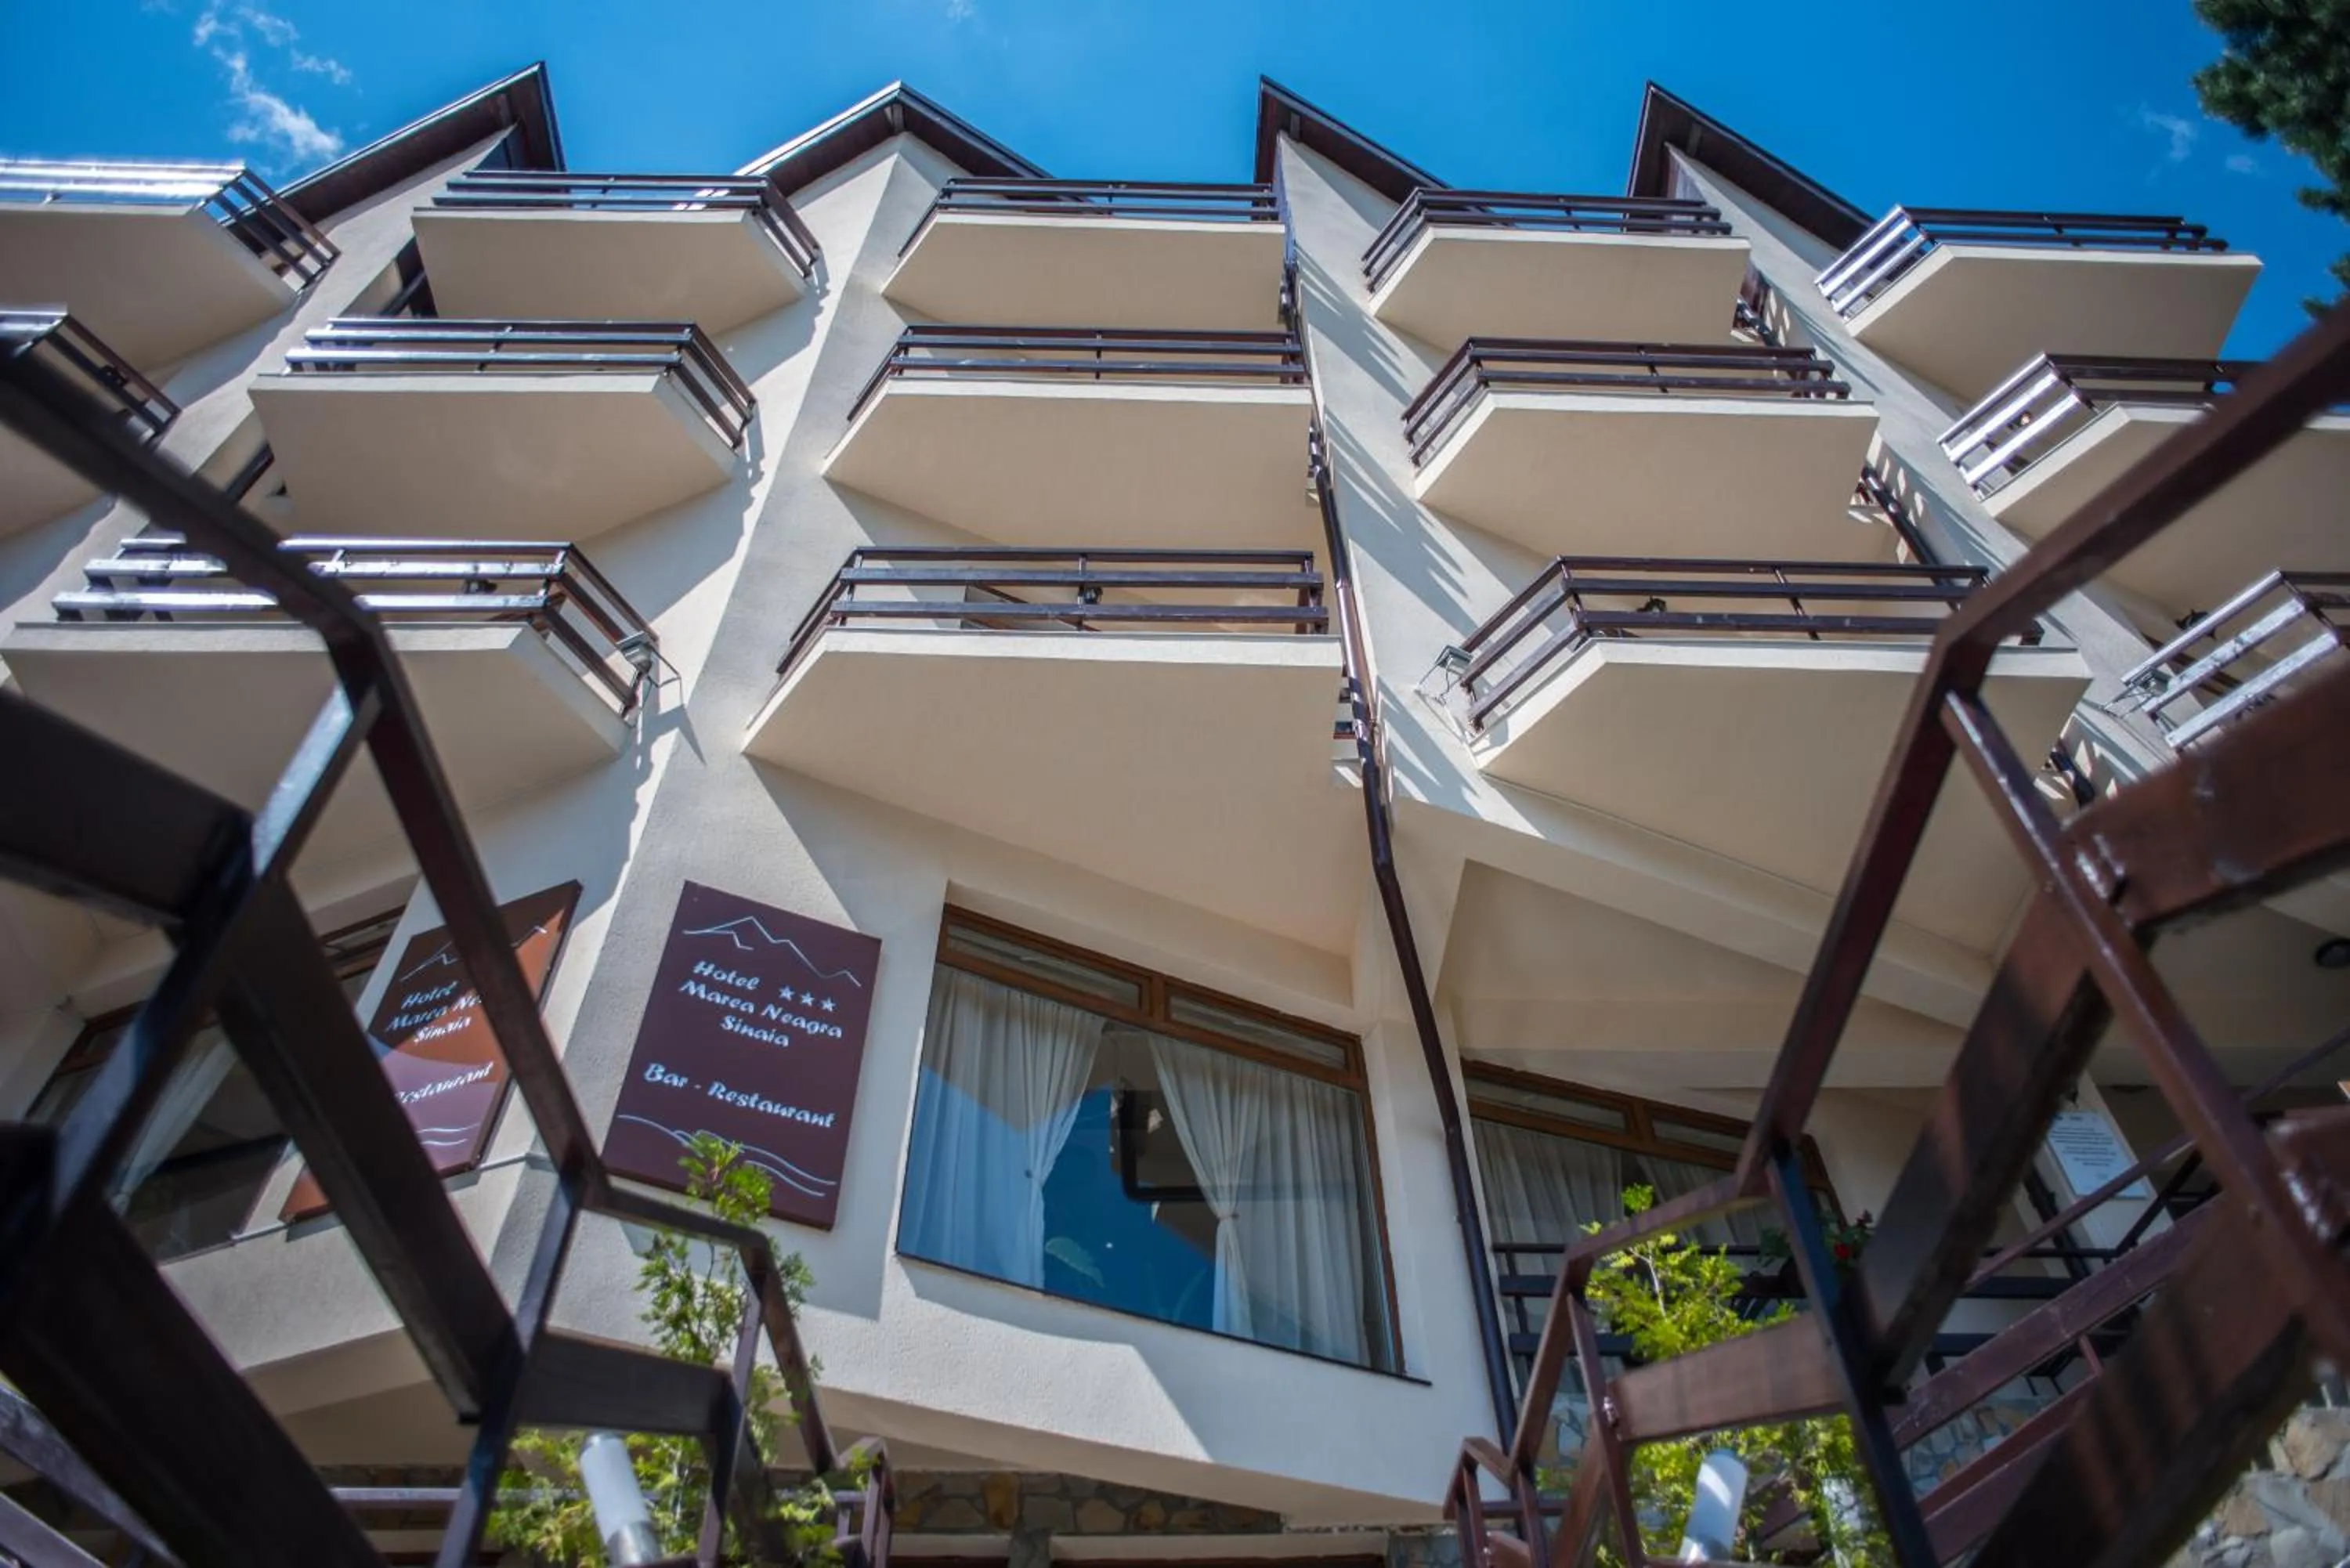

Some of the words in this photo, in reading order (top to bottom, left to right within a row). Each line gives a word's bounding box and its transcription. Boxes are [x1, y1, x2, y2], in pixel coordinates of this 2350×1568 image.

[693, 960, 760, 991] Hotel
[401, 981, 457, 1010] Hotel
[679, 980, 755, 1013] Marea
[761, 1003, 842, 1039] Neagra
[720, 1015, 790, 1047] Sinaia
[644, 1062, 689, 1088] Bar
[707, 1081, 835, 1128] Restaurant
